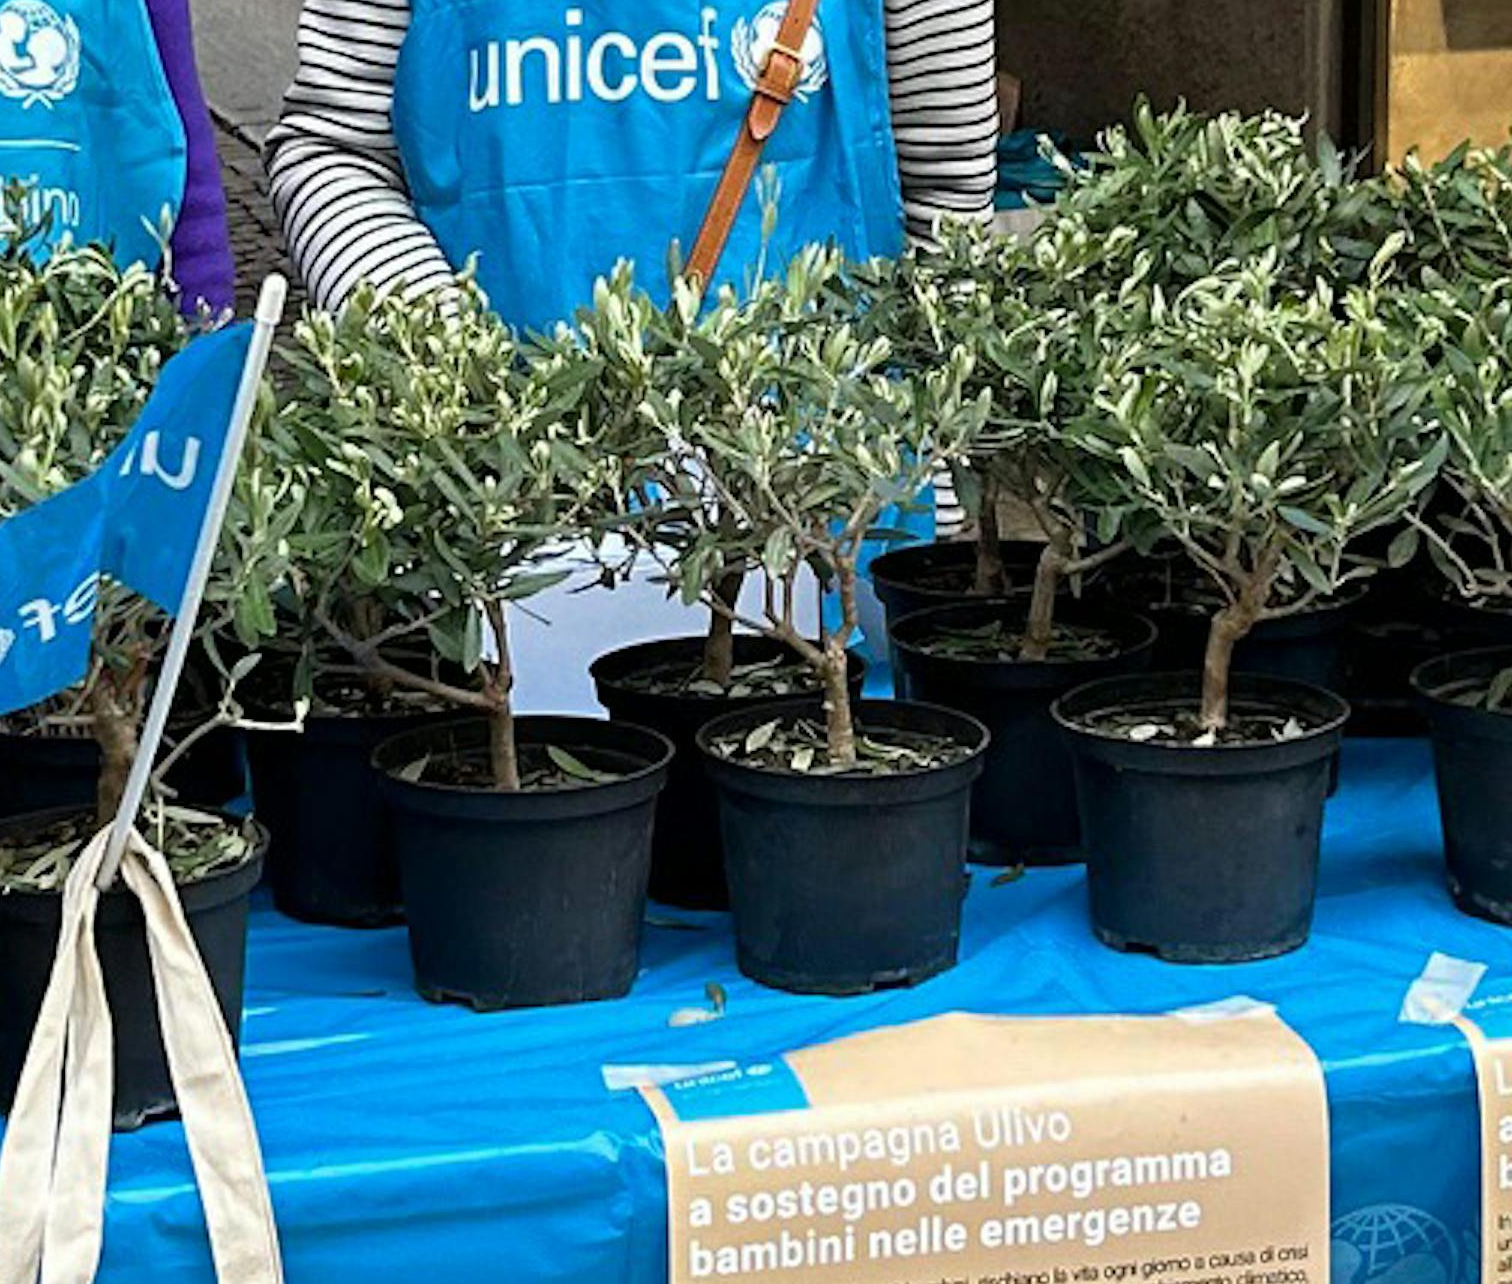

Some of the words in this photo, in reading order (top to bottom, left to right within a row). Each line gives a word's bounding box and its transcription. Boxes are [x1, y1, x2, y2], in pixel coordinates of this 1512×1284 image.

[468, 5, 722, 114] unicef
[688, 1135, 740, 1177] La
[746, 1121, 964, 1172] campagna
[972, 1104, 1072, 1149] Ulivo
[689, 1195, 711, 1227] a
[725, 1175, 915, 1224] sostegno
[929, 1158, 989, 1204] del
[1003, 1146, 1230, 1207] programma
[691, 1222, 854, 1277] bambini
[869, 1214, 967, 1260] nelle
[979, 1199, 1200, 1249] emergenze
